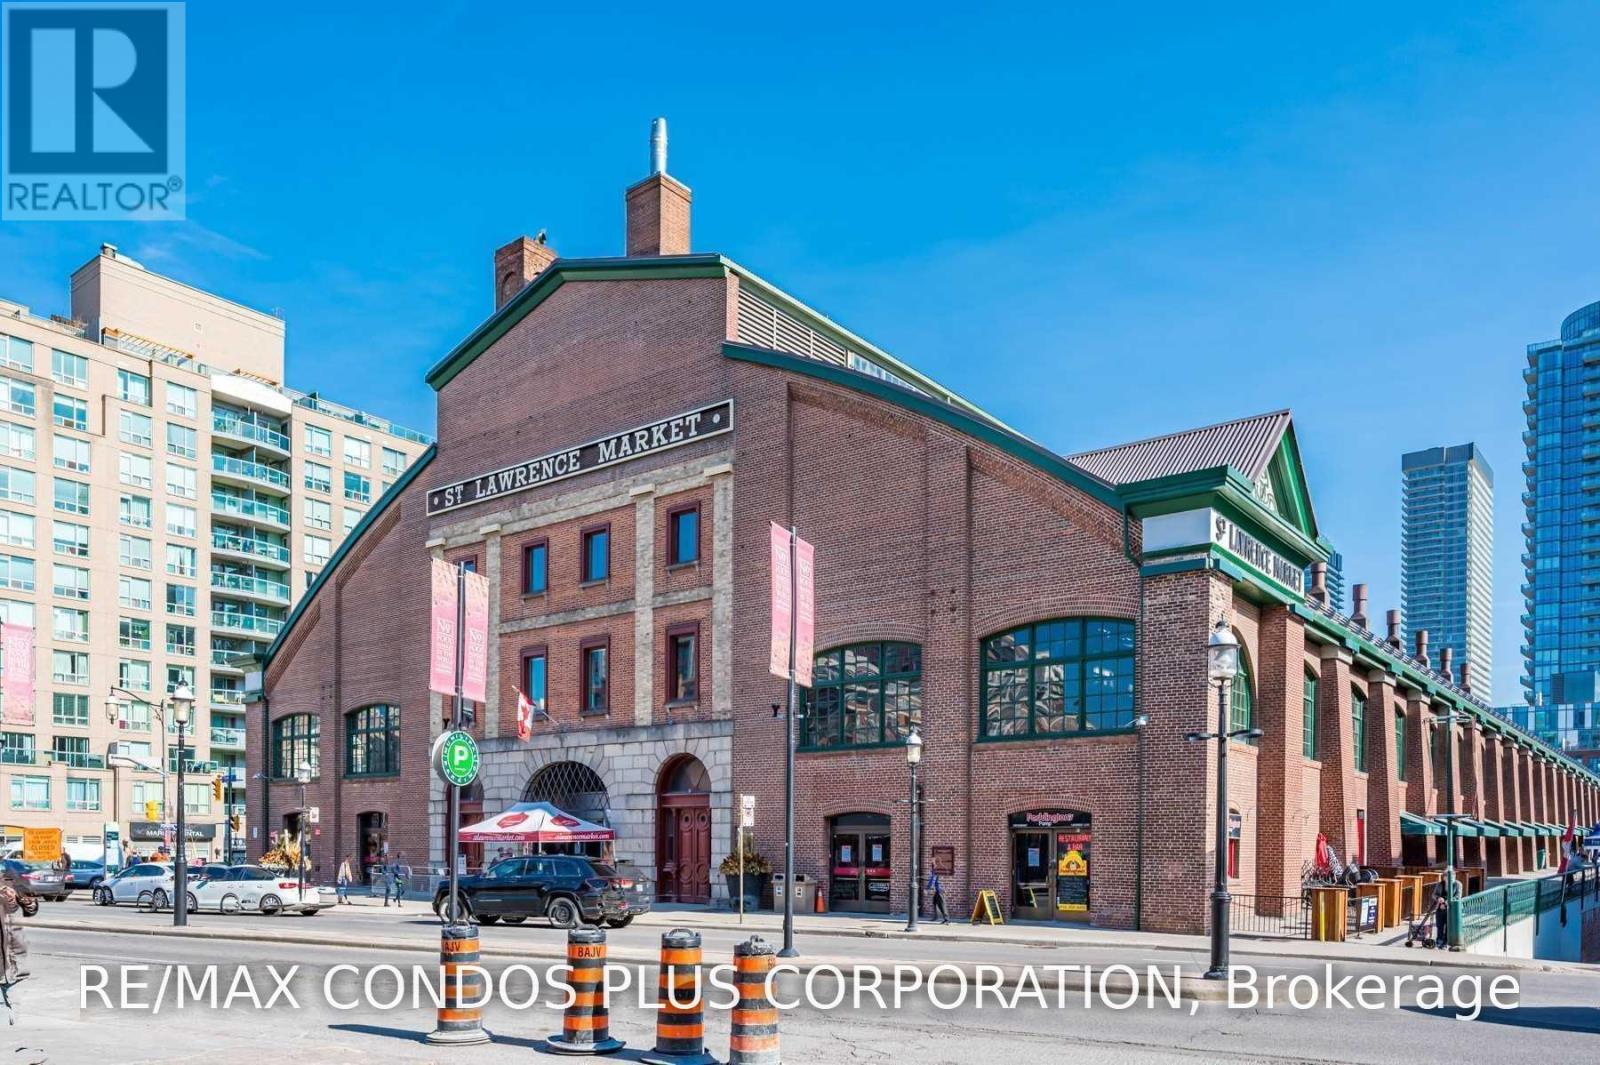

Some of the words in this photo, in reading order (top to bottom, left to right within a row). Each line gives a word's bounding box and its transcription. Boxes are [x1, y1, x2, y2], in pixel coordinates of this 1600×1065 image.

[445, 485, 464, 507] ST
[475, 449, 580, 499] LAWRENCE
[598, 412, 701, 463] MARKET
[1229, 524, 1272, 575] LAWRENCE
[454, 745, 468, 766] P
